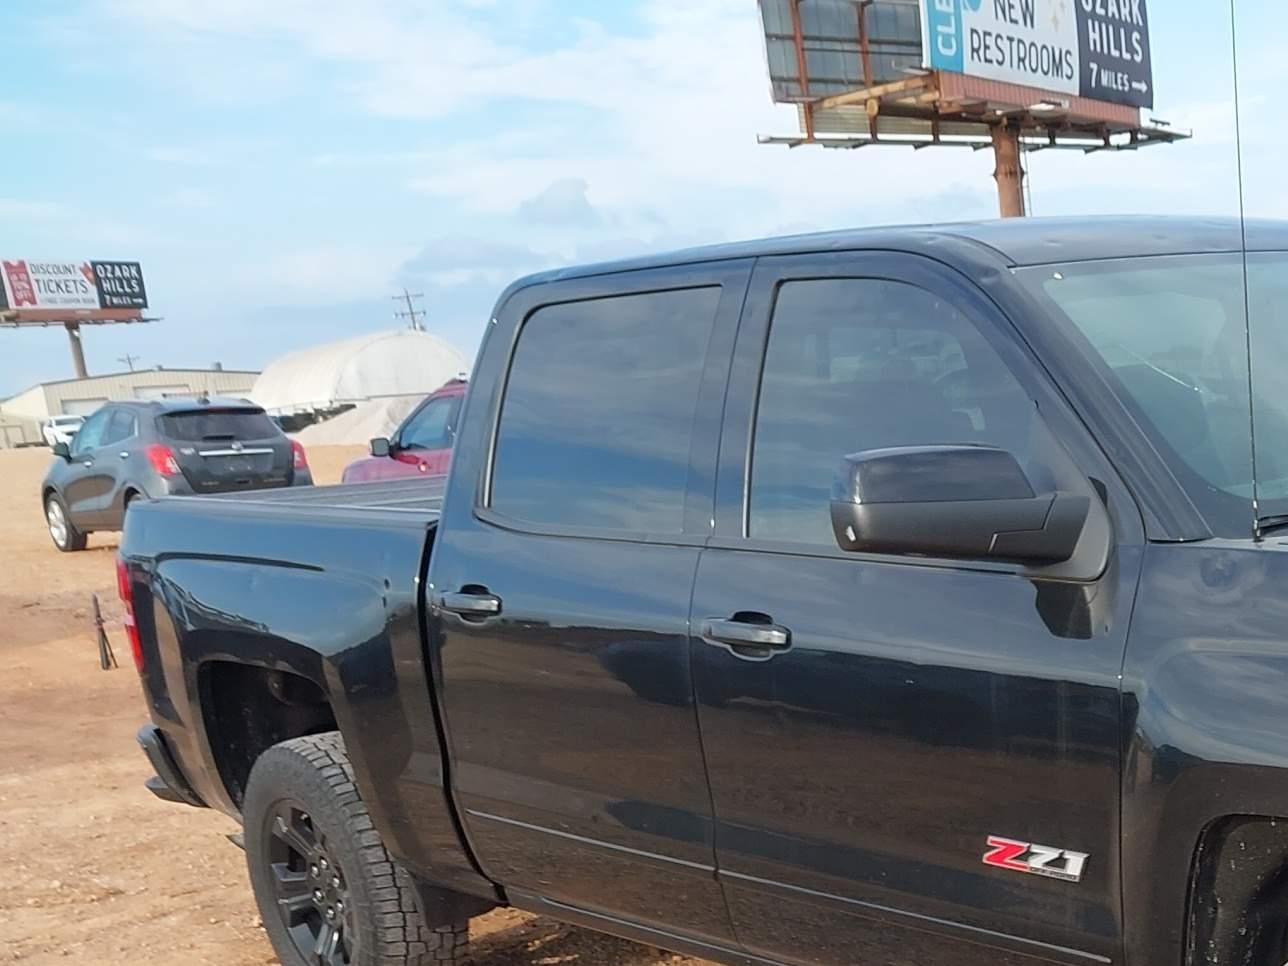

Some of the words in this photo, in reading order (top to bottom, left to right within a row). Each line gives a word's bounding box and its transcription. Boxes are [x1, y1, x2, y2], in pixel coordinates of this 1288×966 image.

[1088, 19, 1143, 63] HILLS
[969, 28, 1074, 81] RESTROOMS
[1089, 62, 1098, 88] 7
[1100, 69, 1130, 92] MILES
[31, 263, 76, 275] DISCOUNT
[96, 264, 139, 279] OZARK
[34, 278, 89, 294] TICKETS
[102, 279, 140, 293] HILLS
[982, 835, 1090, 880] Z71
